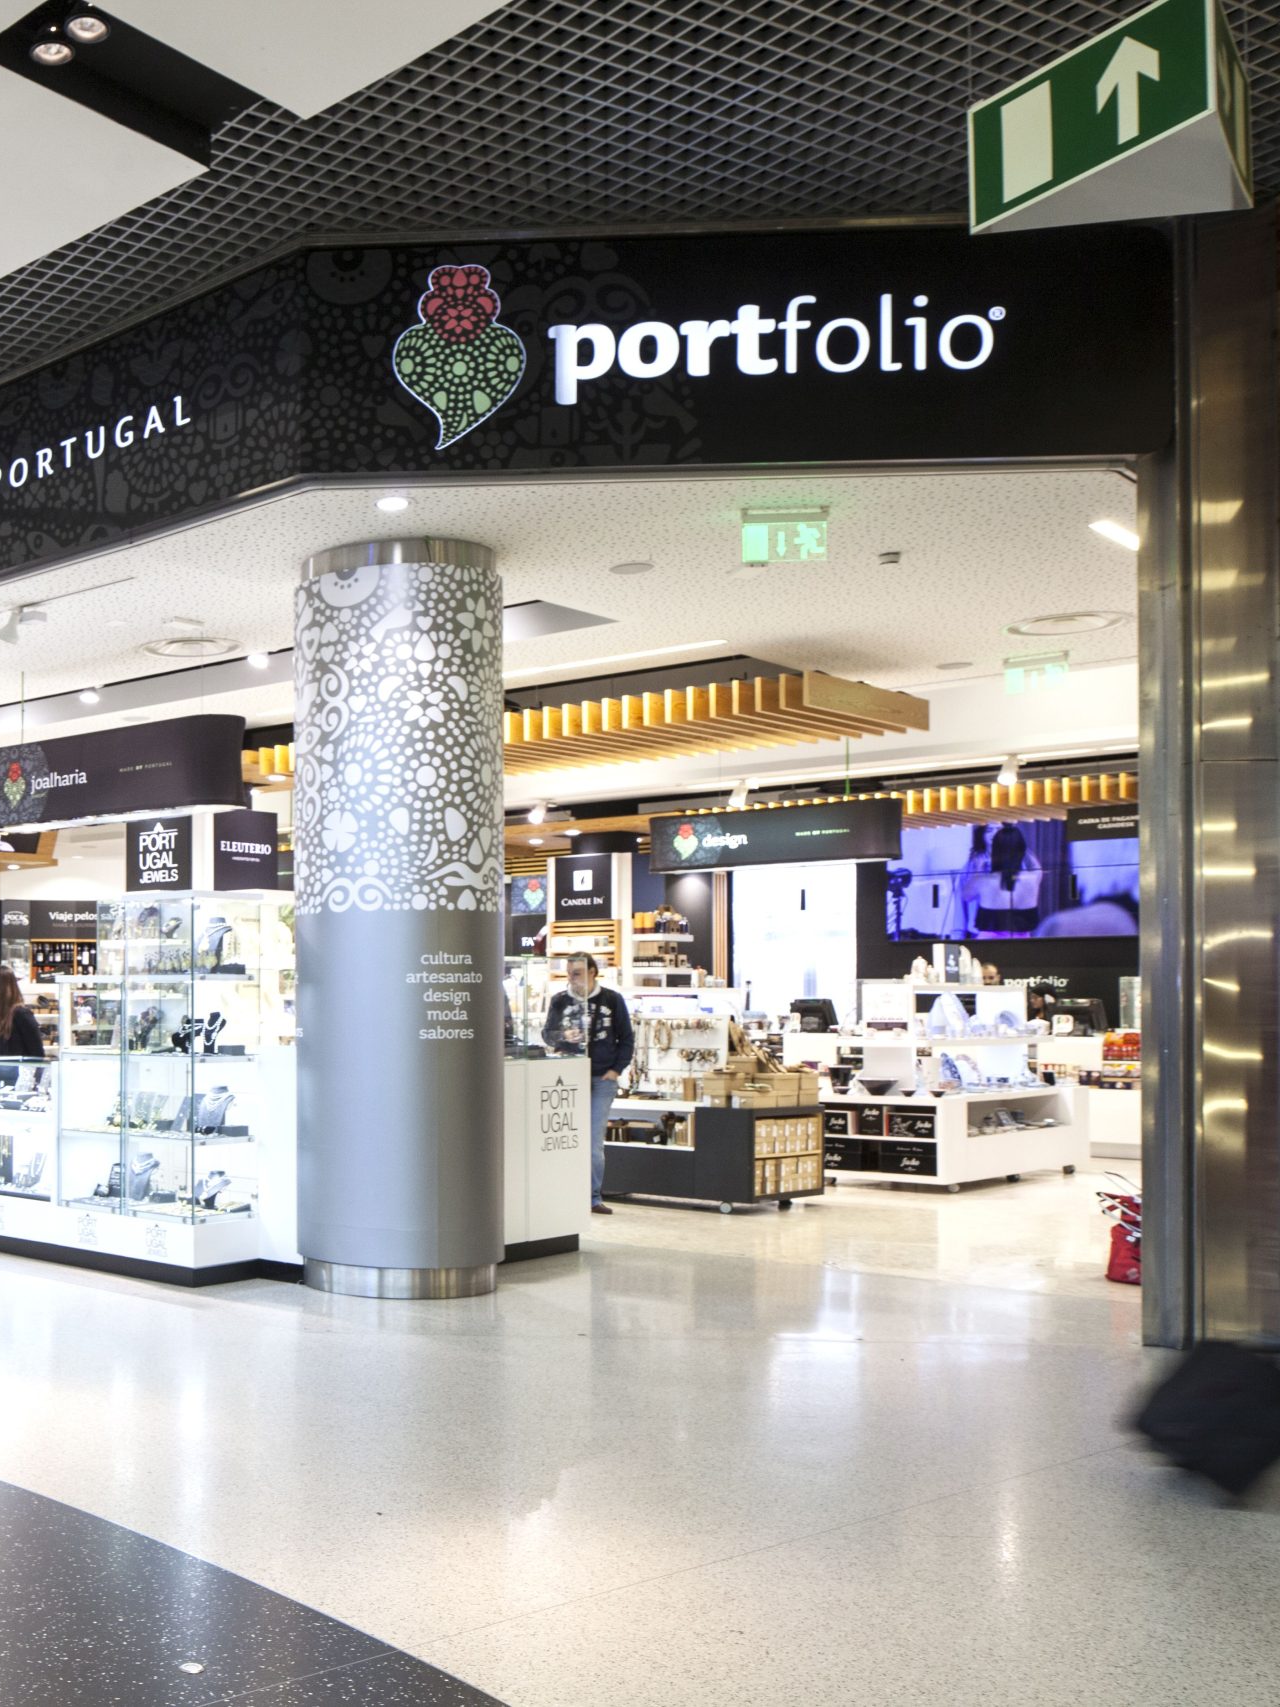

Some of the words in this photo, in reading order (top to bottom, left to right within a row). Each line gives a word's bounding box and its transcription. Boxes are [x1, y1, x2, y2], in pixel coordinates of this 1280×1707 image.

[31, 769, 87, 795] joalharia
[139, 832, 178, 852] PORT
[221, 840, 272, 855] ELEUTERIO
[702, 832, 749, 849] design
[139, 851, 178, 870] UGAL
[139, 869, 179, 884] JEWELS
[49, 911, 73, 923] Viaje
[421, 951, 472, 965] cultura
[406, 970, 483, 984] artesanato
[423, 988, 471, 1005] design
[427, 1007, 468, 1021] moda
[419, 1025, 474, 1040] sabores
[540, 1088, 578, 1110] PORT
[540, 1112, 578, 1133] UGAL
[540, 1134, 579, 1152] JEWELS
